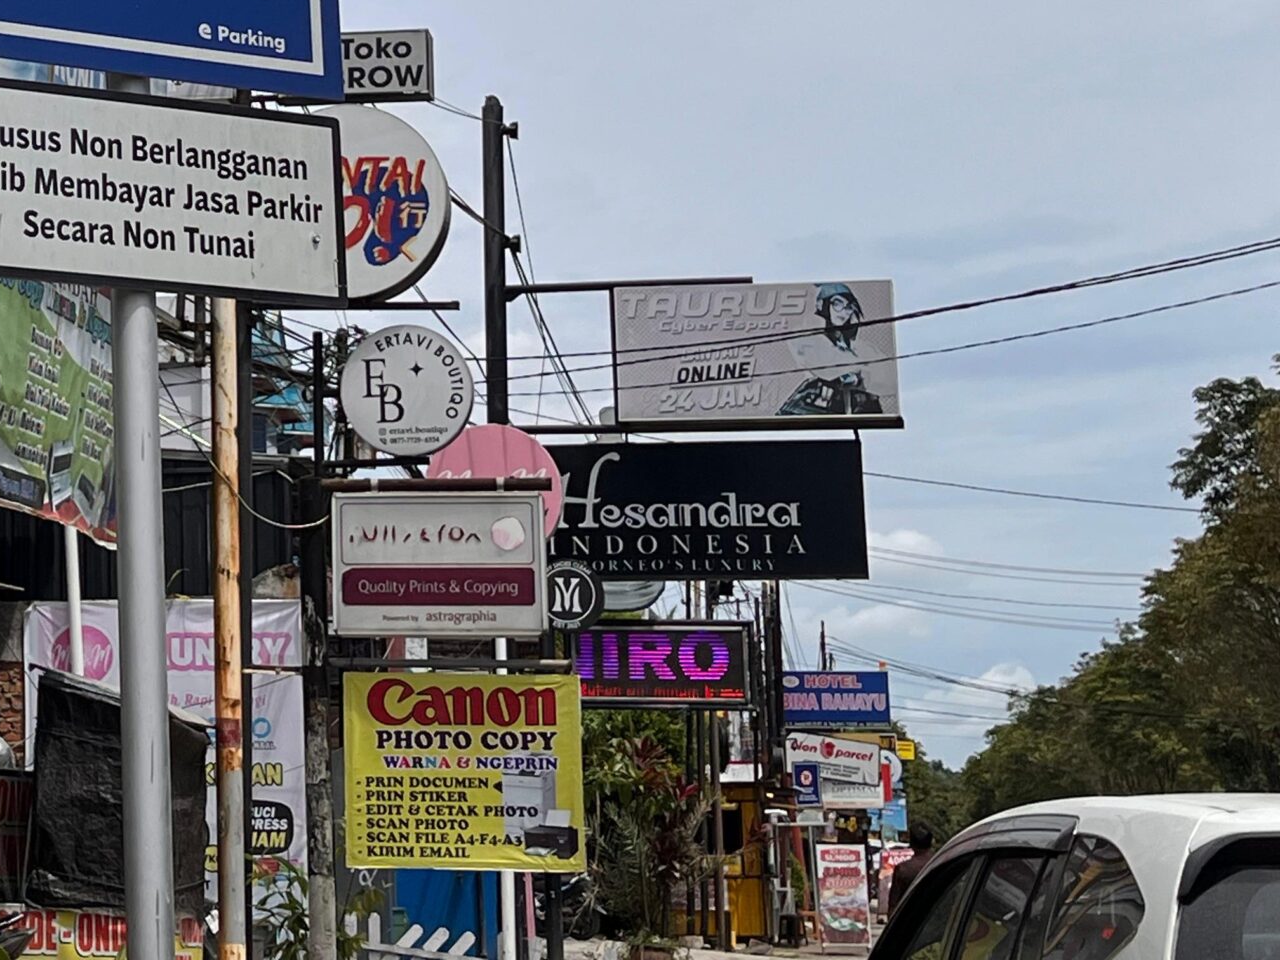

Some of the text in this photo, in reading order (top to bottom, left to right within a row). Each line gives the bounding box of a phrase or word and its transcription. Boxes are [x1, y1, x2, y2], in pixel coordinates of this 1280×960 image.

[198, 23, 286, 53] e Parking
[342, 38, 412, 60] Toko
[342, 64, 424, 88] ROW
[69, 128, 124, 160] Non
[131, 135, 309, 182] Berlangganan
[34, 167, 176, 213] Membayar
[183, 184, 240, 215] Jasa
[247, 191, 324, 223] Parkir
[23, 210, 256, 259] Secara Non Tunai
[621, 289, 809, 320] TAURUS
[658, 317, 790, 335] Cyber Esport
[375, 332, 464, 420] ERTAVI BOUTIQO
[677, 361, 751, 384] ONLINE
[658, 383, 762, 414] 24 JAM
[558, 452, 802, 529] Hesandra
[550, 534, 806, 556] INDONESIA
[580, 558, 776, 572] ORNEO'S LUXURY
[358, 579, 519, 597] Quality Prints & Copying
[382, 610, 497, 625] Powered by astragraphia
[804, 674, 862, 689] HOTEL
[367, 678, 557, 727] Canon
[821, 693, 886, 711] RAHAYU
[376, 730, 557, 751] PHOTO COPY
[383, 756, 558, 770] WARNA & NGEPRIN
[835, 749, 874, 761] parcel
[365, 776, 489, 789] PRIN DOCUMEN
[365, 790, 469, 802] PRIN STIKER
[251, 807, 275, 818] UCI
[366, 804, 539, 818] EDIT & CETAK PHOTO
[366, 818, 469, 830] SCAN PHOTO
[366, 831, 523, 847] SCAN FILE A4-F4-A3
[367, 846, 470, 858] KIRIM EMAIL
